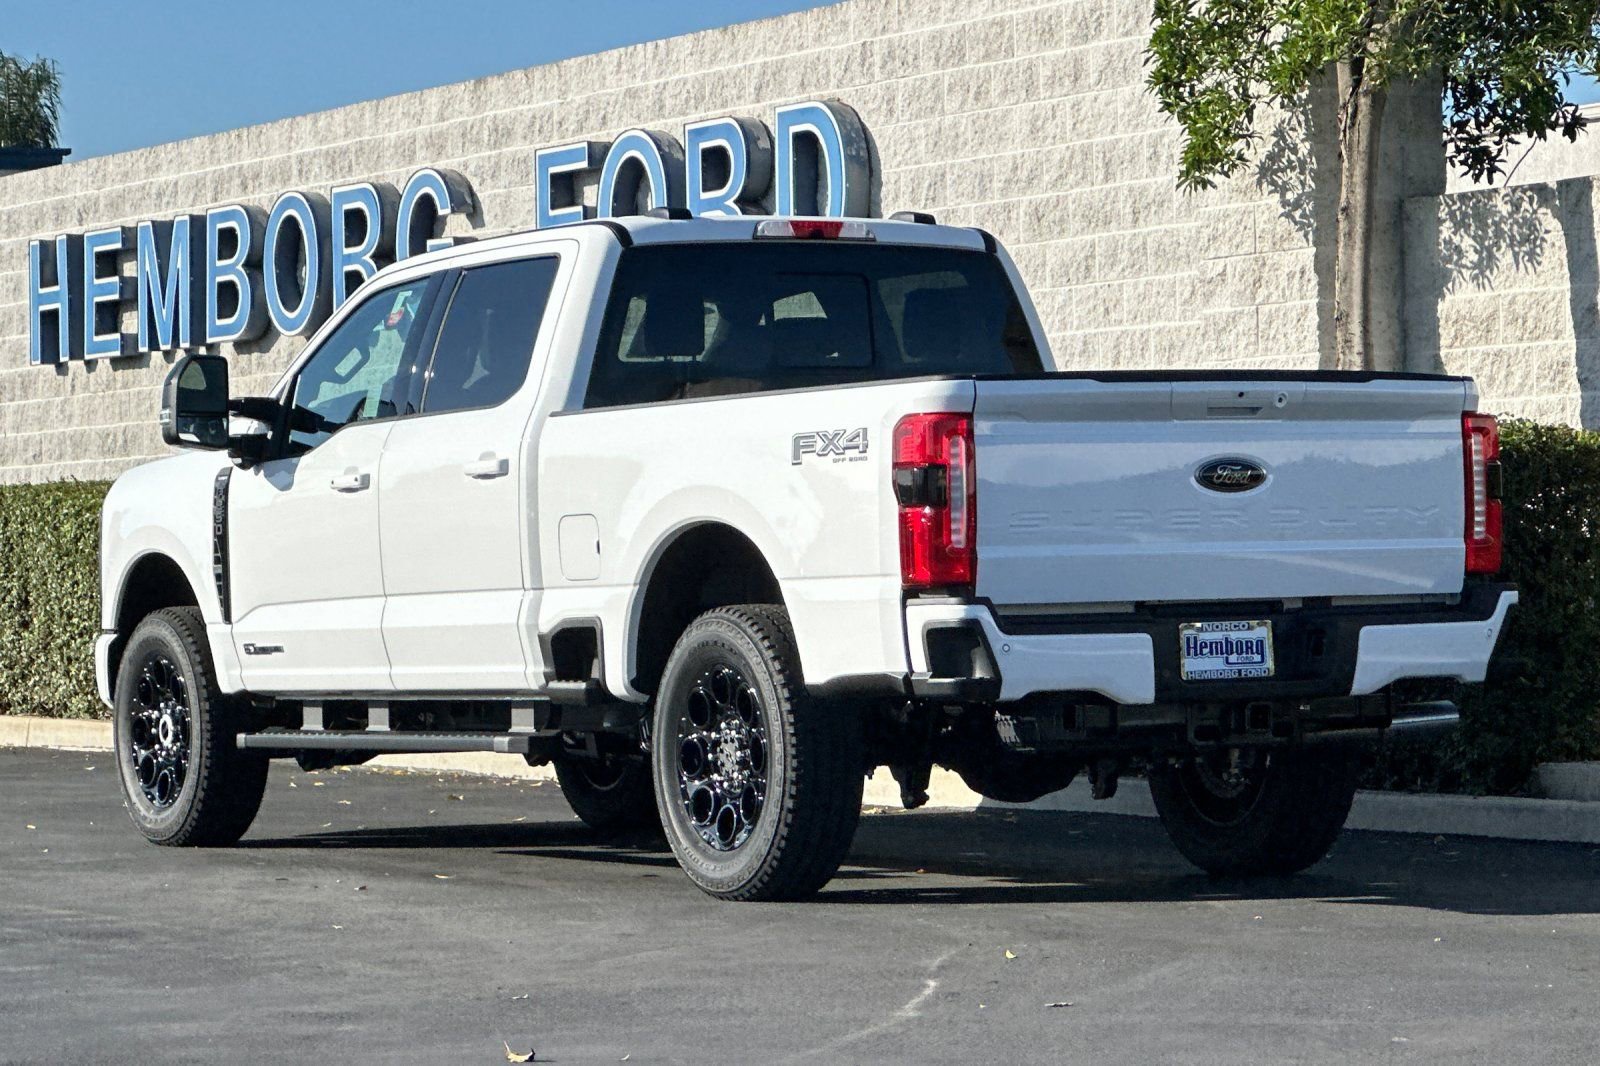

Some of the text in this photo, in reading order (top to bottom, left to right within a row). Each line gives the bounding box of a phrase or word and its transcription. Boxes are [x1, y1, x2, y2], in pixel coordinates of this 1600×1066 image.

[28, 167, 458, 366] HEMBORG
[792, 428, 868, 466] FX4
[1213, 464, 1251, 485] Ford
[1202, 621, 1249, 632] NORCO
[1185, 635, 1265, 665] Hemborg
[1188, 668, 1269, 679] HEMBORG FORD
